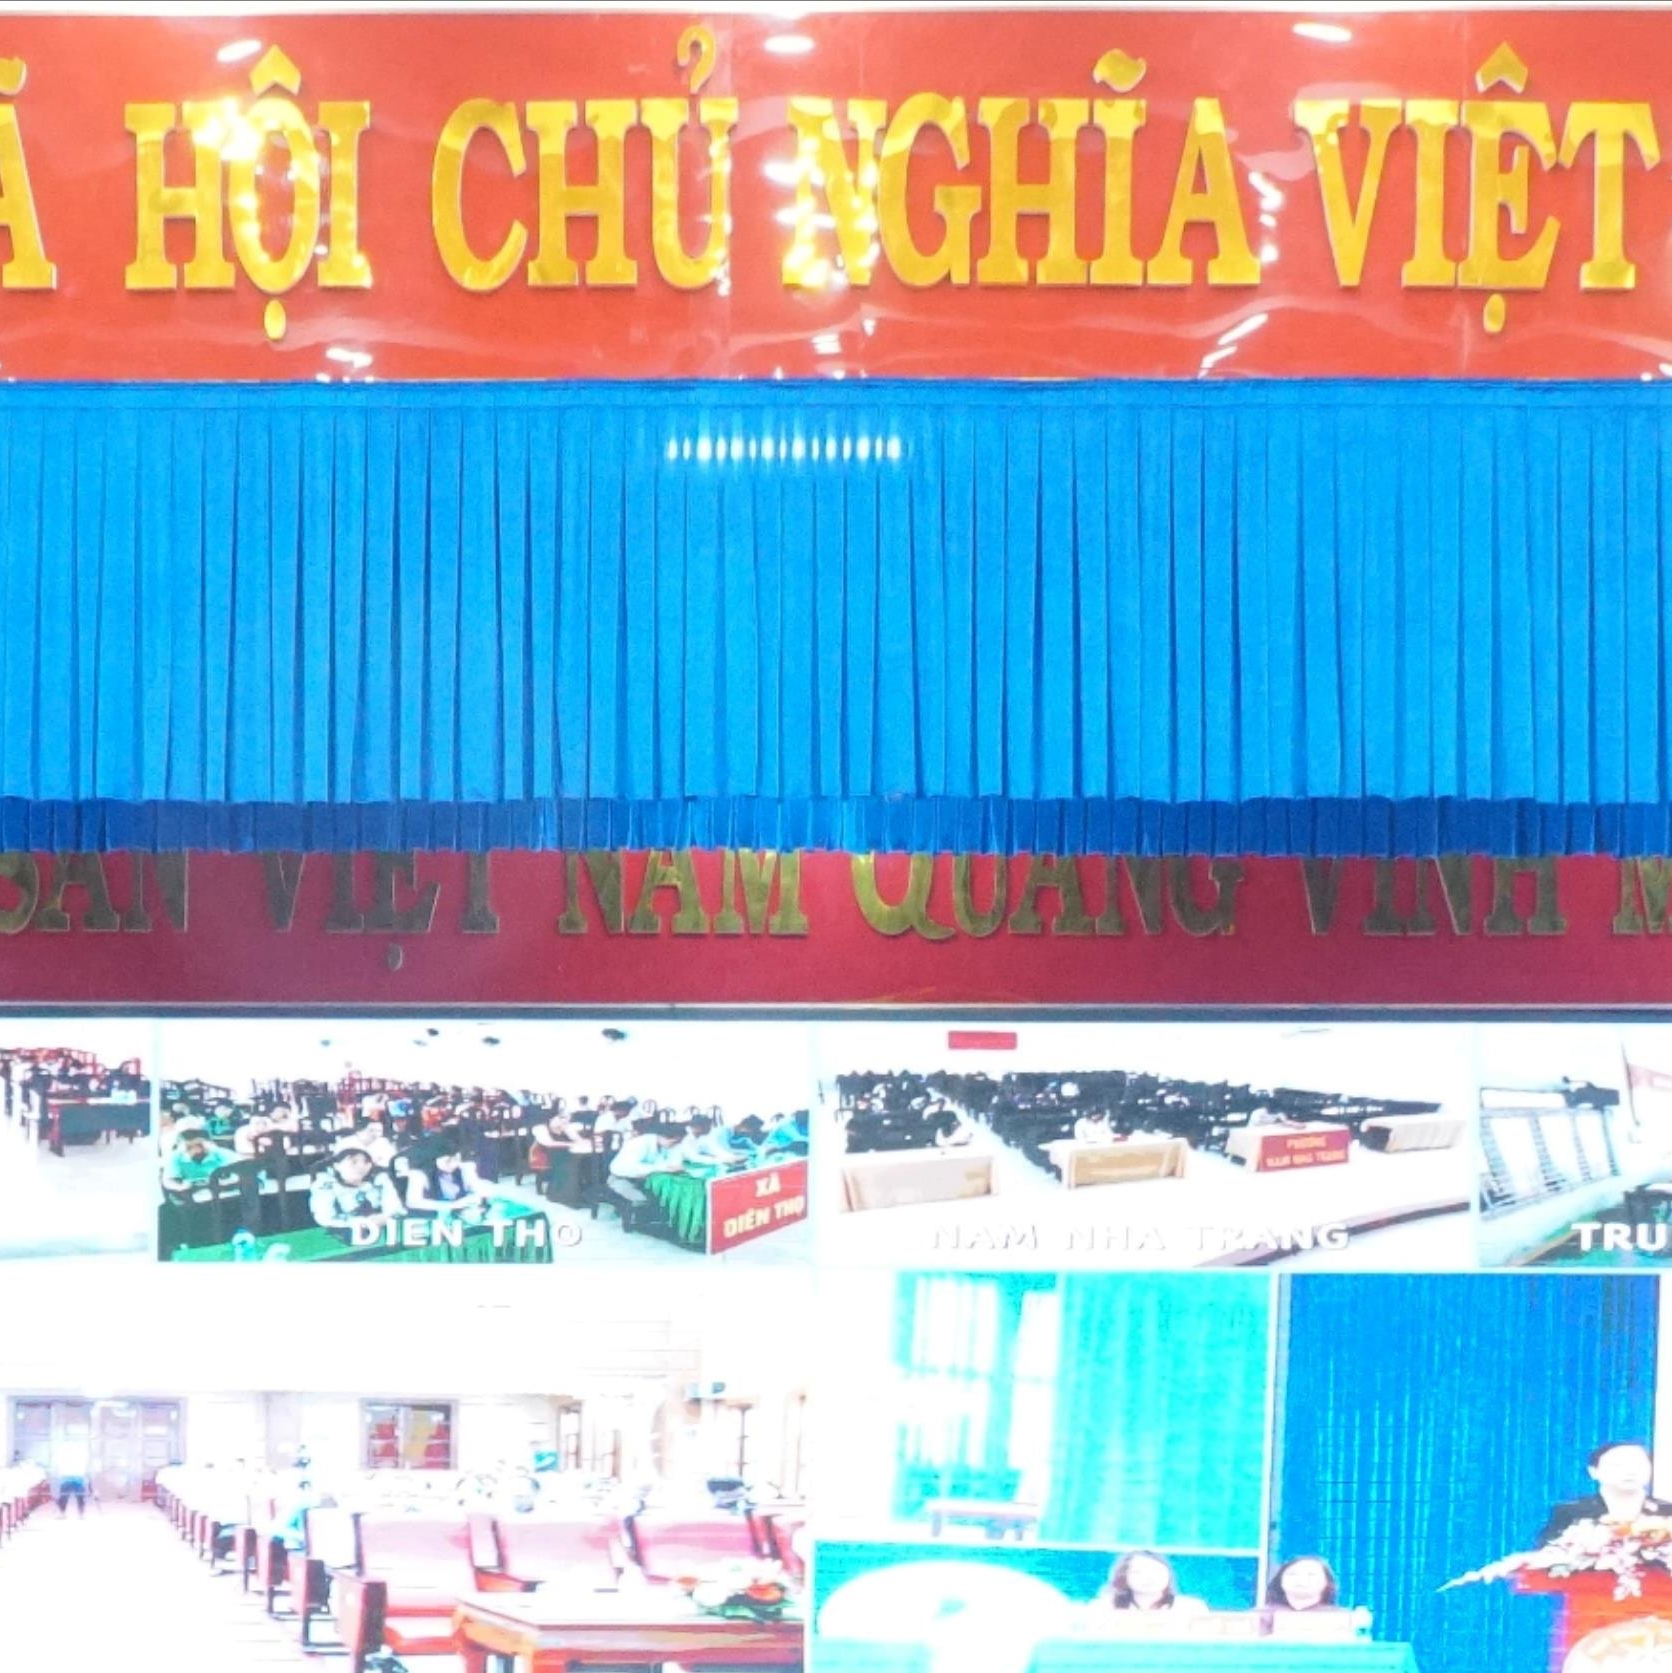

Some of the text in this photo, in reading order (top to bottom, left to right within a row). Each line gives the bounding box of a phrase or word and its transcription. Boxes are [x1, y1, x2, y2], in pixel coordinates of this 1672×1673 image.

[123, 44, 372, 341] HỘI
[431, 24, 731, 291] CHỦ
[779, 48, 1260, 291] NGHĨA
[1293, 41, 1661, 333] VIỆT
[350, 1218, 463, 1247] DIEN
